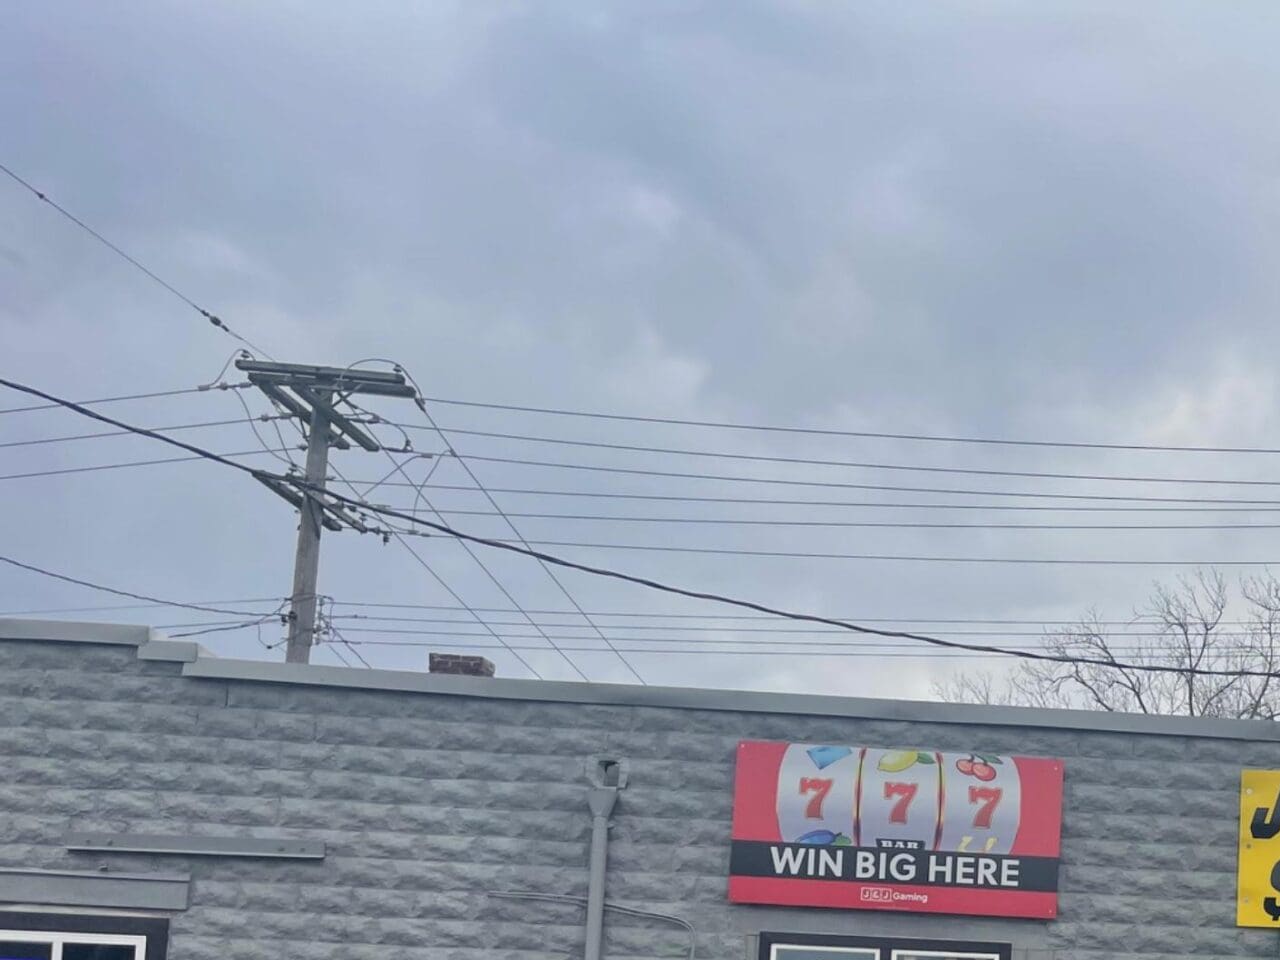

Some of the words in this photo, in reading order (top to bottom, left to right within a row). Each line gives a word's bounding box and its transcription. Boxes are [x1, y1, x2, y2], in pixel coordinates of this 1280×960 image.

[800, 777, 834, 821] 7
[884, 781, 919, 825] 7
[968, 785, 1002, 829] 7
[880, 840, 919, 849] BAR
[770, 846, 843, 878] WIN
[856, 852, 916, 882] BIG
[928, 855, 1020, 887] HERE
[893, 892, 928, 903] Gaming
